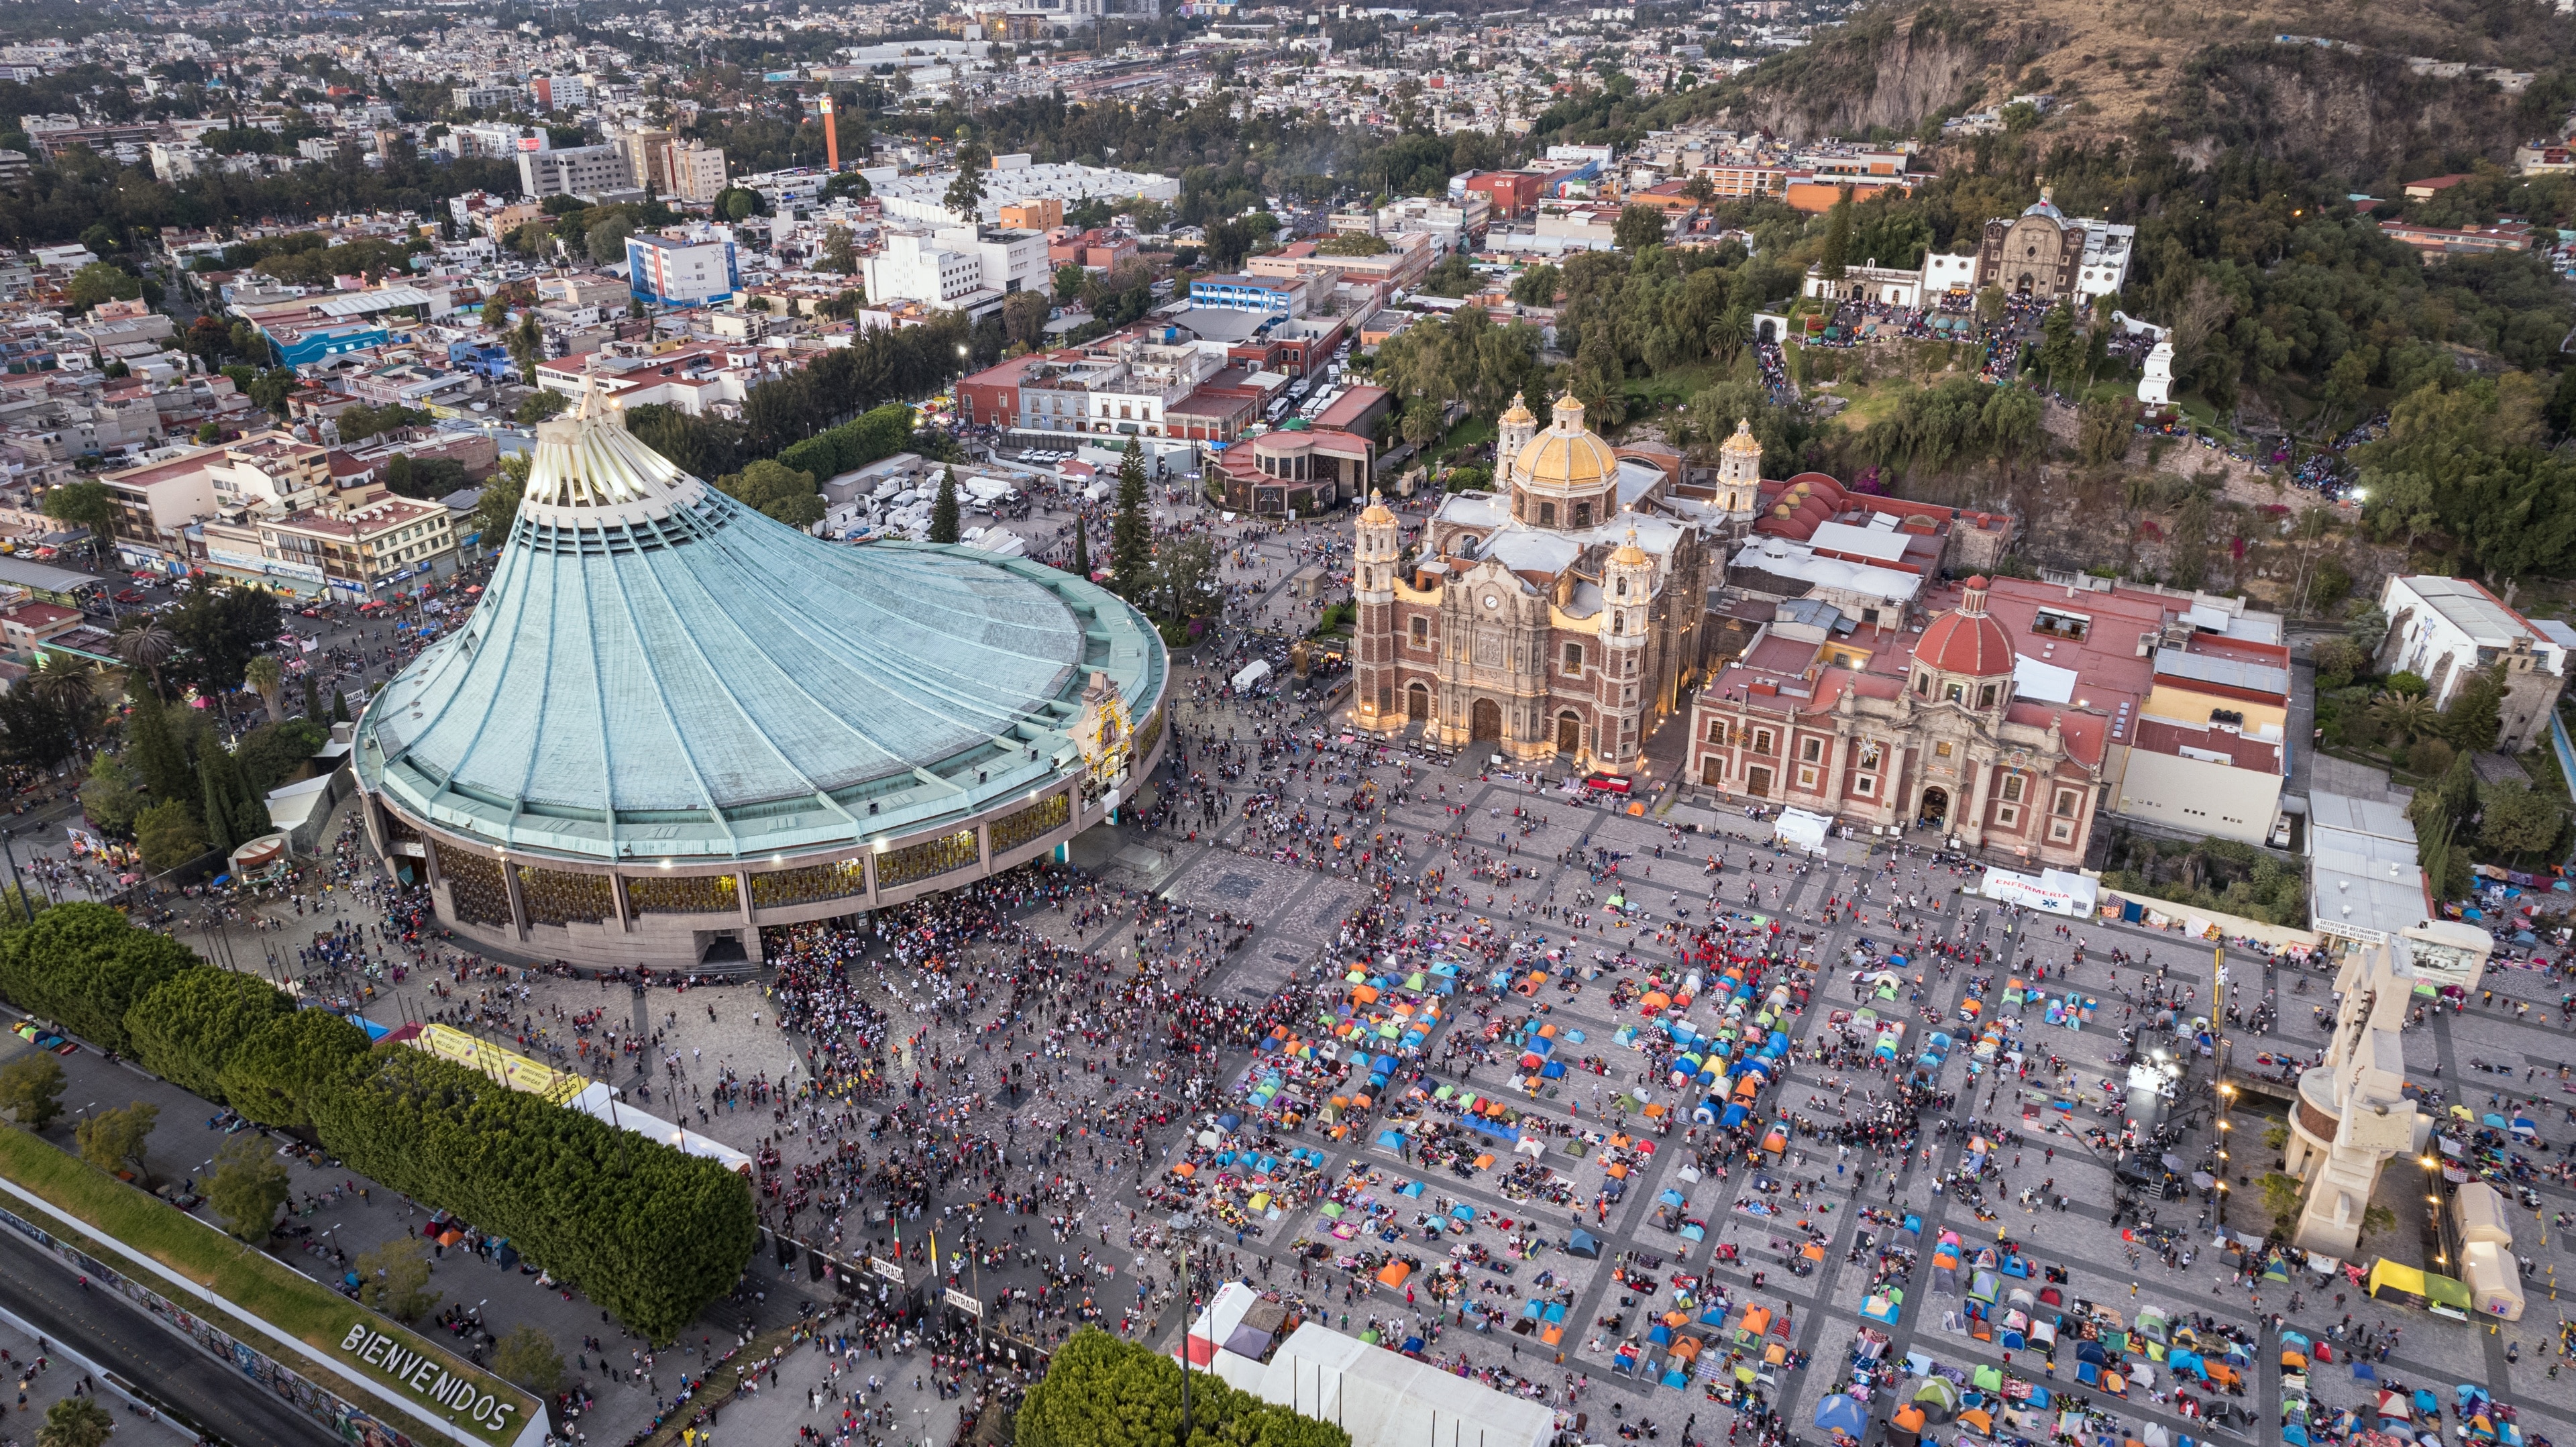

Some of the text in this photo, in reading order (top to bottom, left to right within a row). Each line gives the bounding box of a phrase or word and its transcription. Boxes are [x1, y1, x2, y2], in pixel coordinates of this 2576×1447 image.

[1995, 879, 2070, 898] ENFERMERIA
[2315, 924, 2339, 934] BASILICA
[2320, 920, 2381, 937] ARTICULOS RELIGIOSOS
[438, 1032, 463, 1045] URGENCIAS
[522, 1067, 549, 1081] URGENCIAS
[545, 1081, 567, 1097] UESTO
[552, 1083, 577, 1102] MANDO
[873, 1259, 904, 1281] ENTRADA
[340, 1323, 515, 1431] BIENVENIDOS
